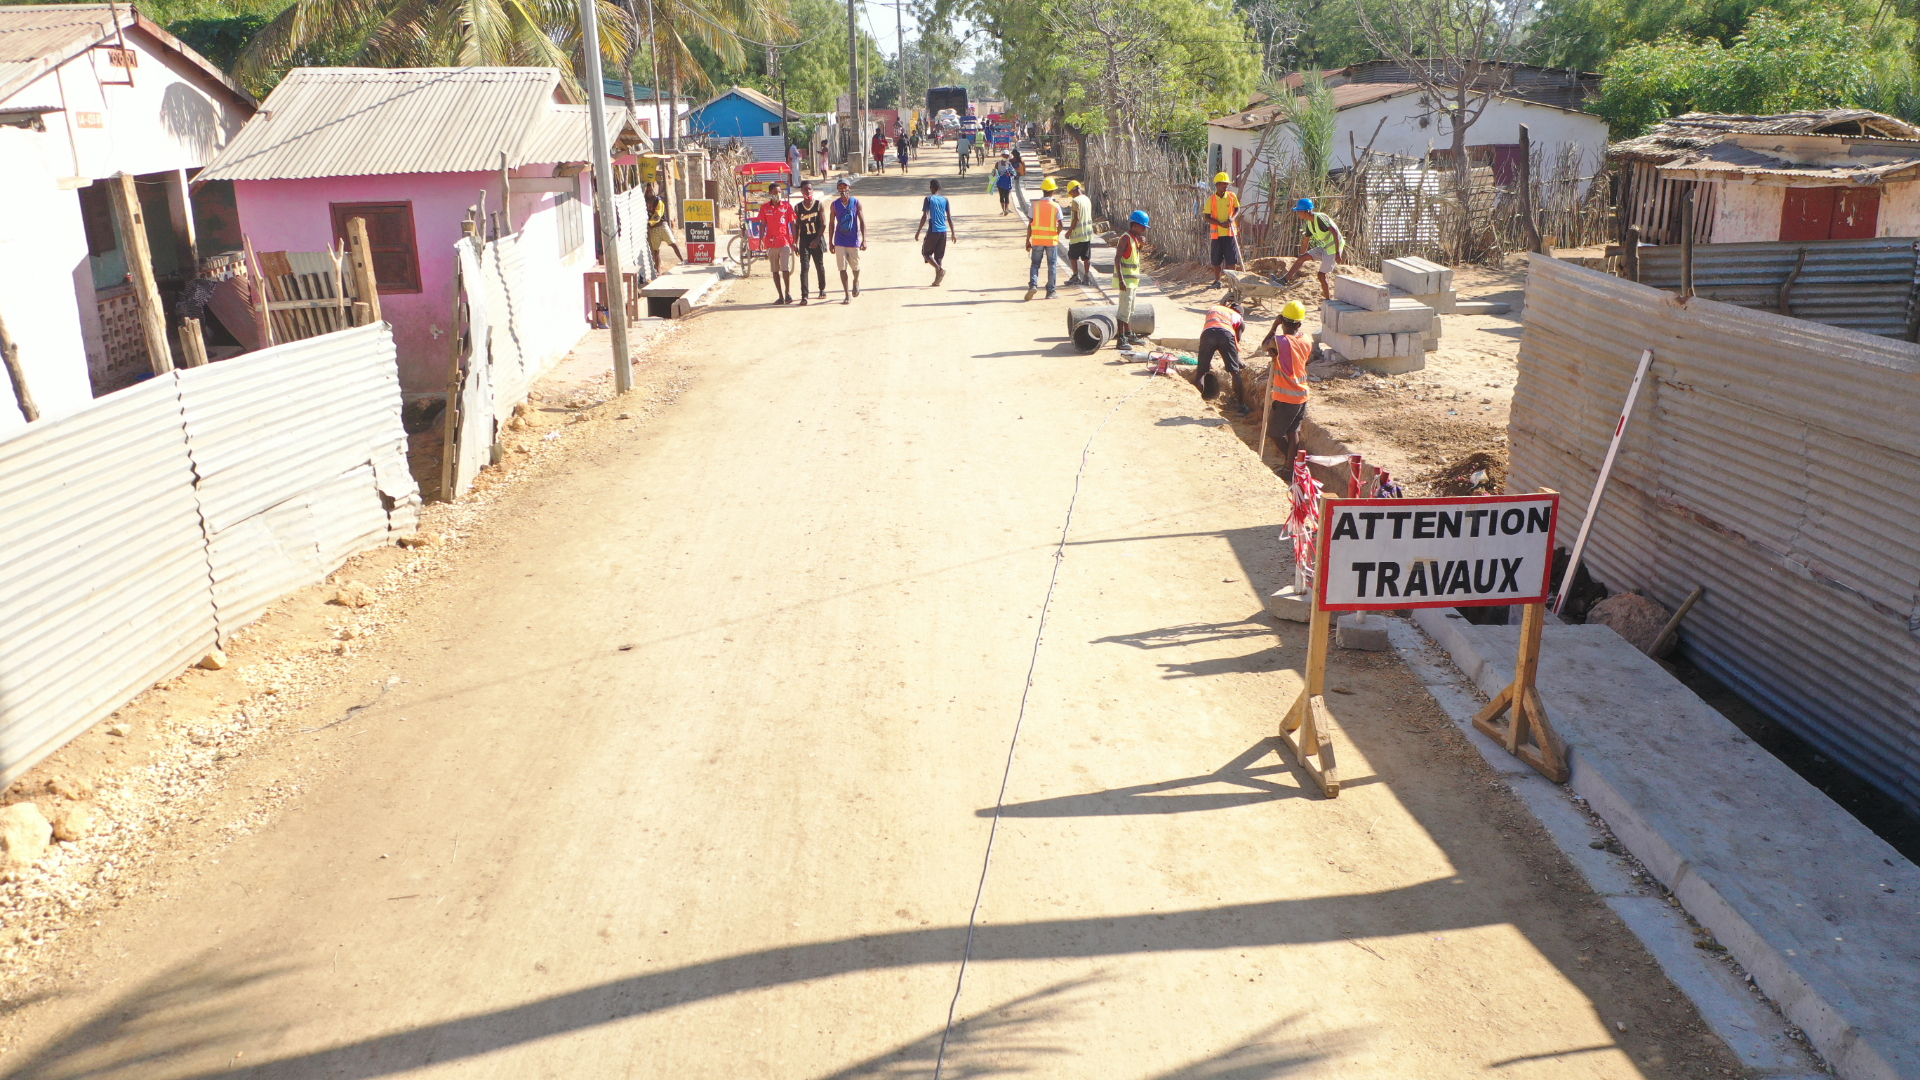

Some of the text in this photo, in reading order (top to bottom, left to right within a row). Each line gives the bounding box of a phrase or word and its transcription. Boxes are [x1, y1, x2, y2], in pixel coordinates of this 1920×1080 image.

[805, 222, 817, 234] 11
[1331, 507, 1552, 540] ATTENTION
[1352, 557, 1524, 598] TRAVAUX
